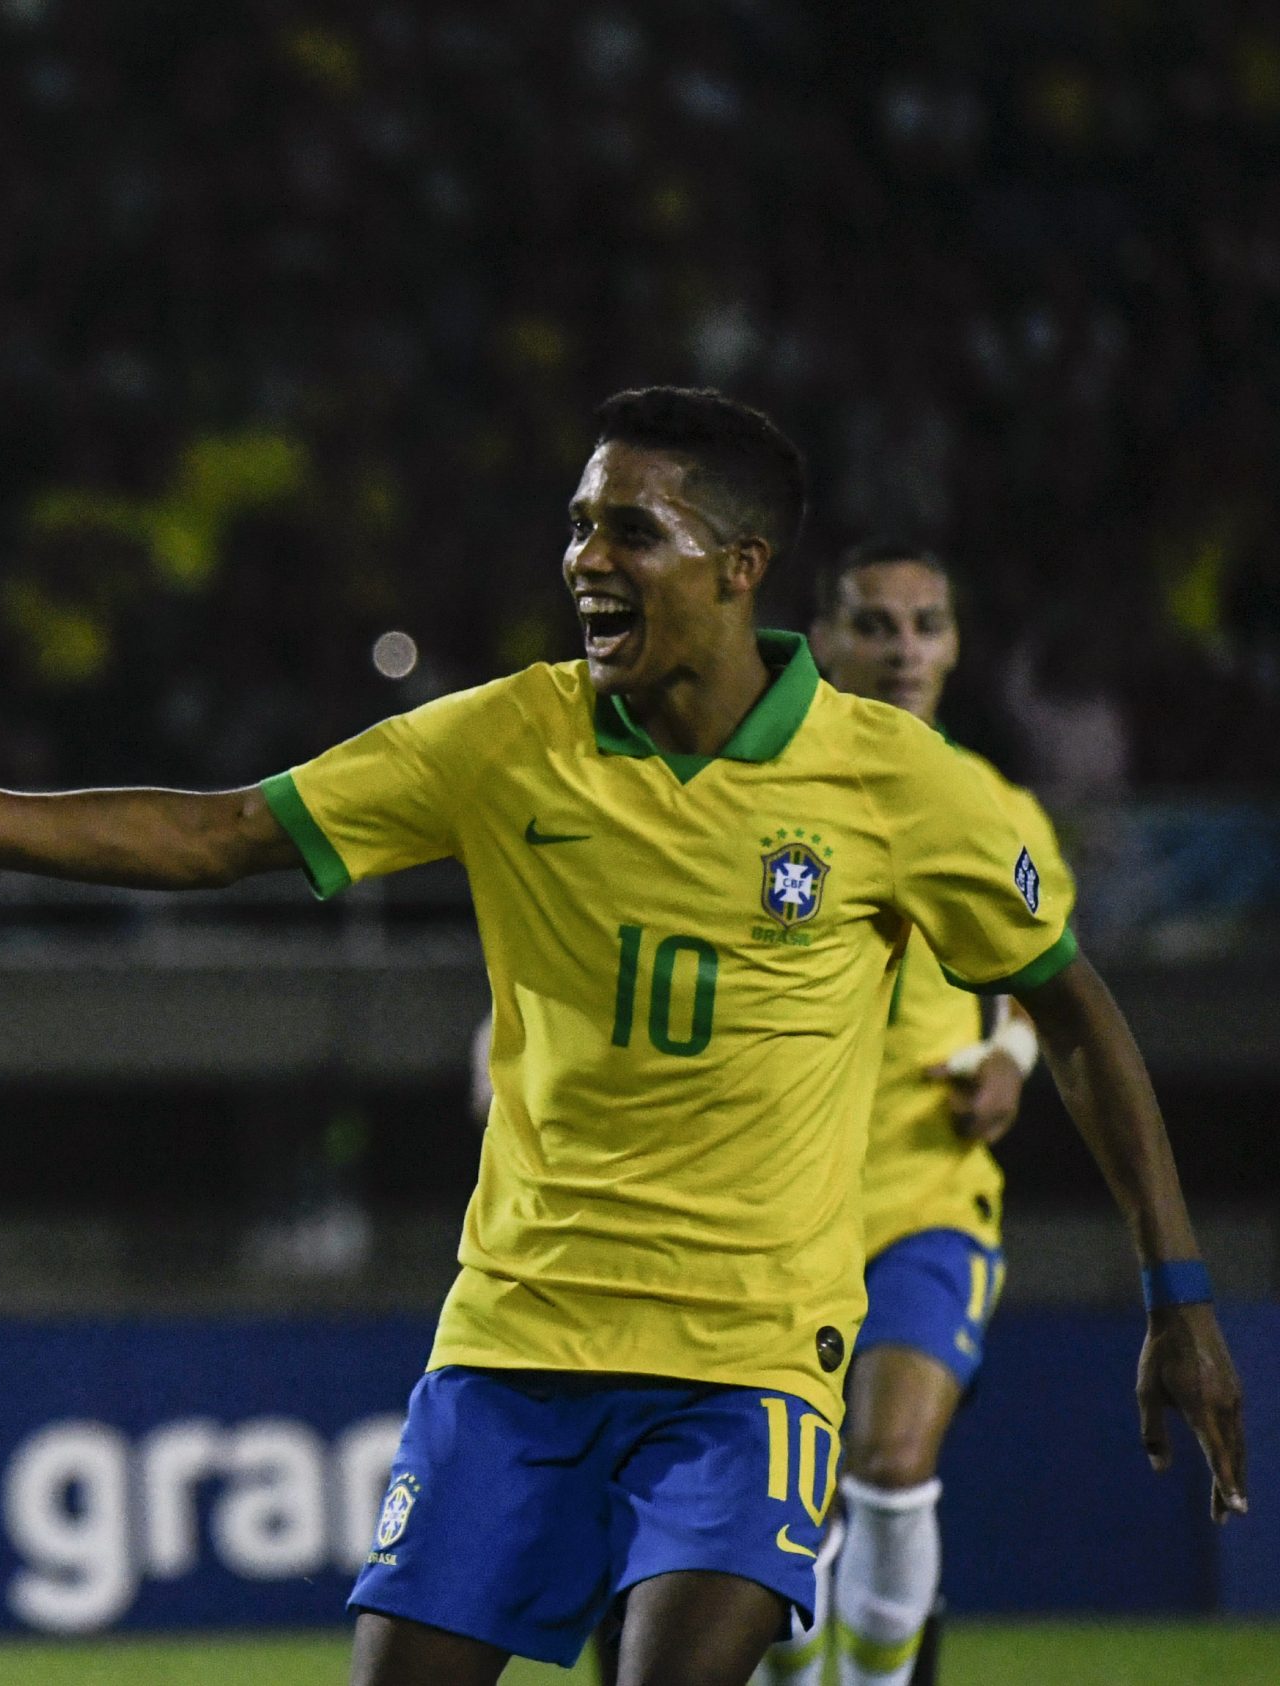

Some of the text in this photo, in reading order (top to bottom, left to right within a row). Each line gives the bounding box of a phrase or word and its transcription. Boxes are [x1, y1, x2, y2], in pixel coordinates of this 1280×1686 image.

[782, 877, 805, 889] CBF
[611, 924, 719, 1057] 10
[761, 1397, 842, 1528] 10
